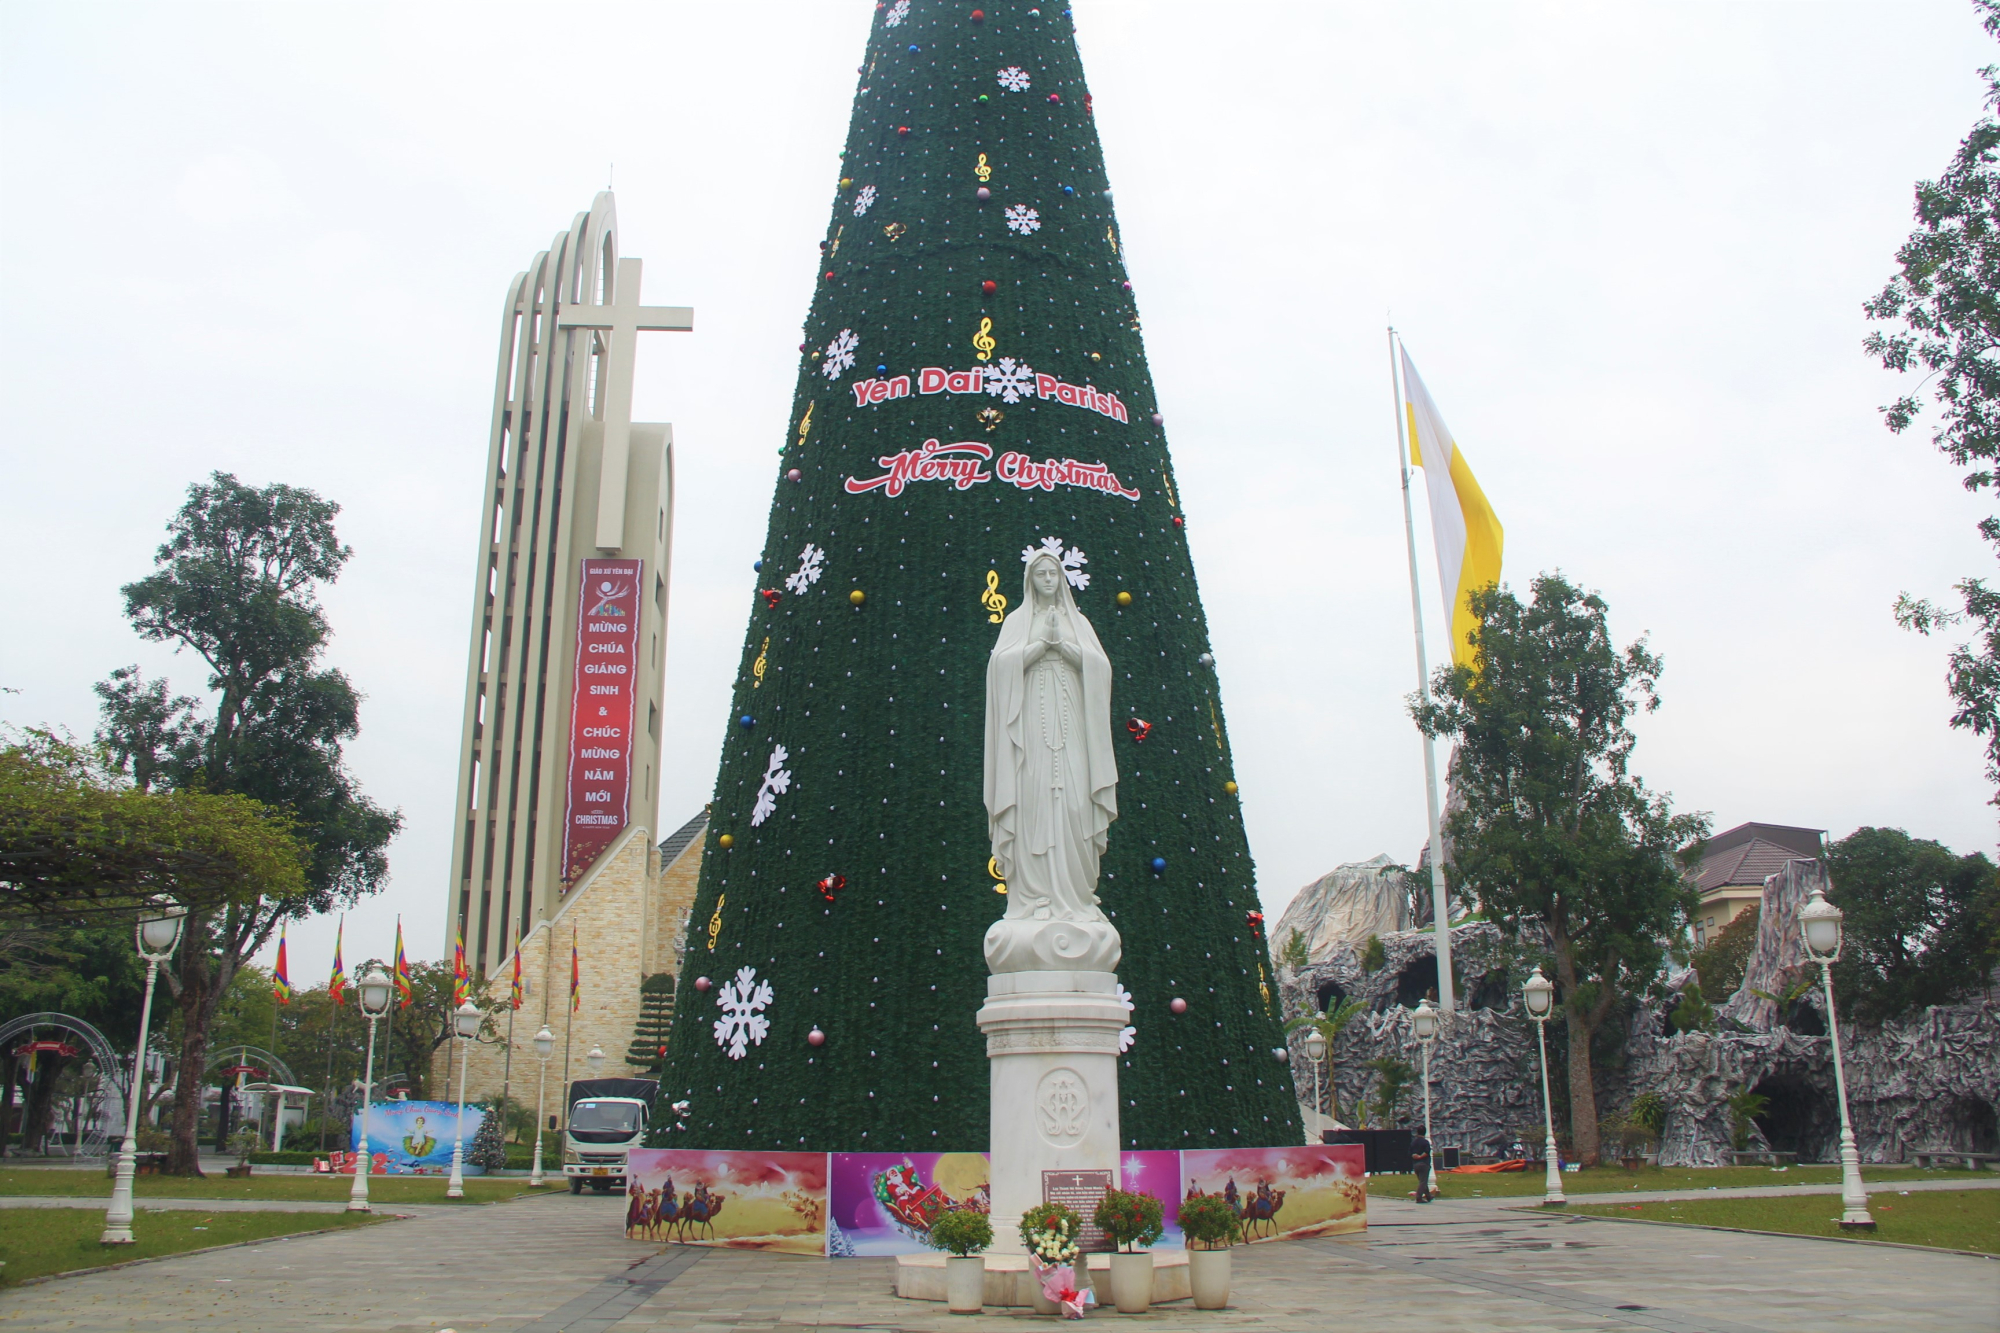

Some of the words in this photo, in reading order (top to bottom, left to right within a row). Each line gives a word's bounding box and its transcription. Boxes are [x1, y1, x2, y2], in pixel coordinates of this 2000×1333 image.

[852, 375, 911, 408] Yen
[918, 366, 984, 396] Dai
[1034, 372, 1130, 425] Parish
[844, 437, 994, 499] Merry
[995, 450, 1142, 502] Christmas
[588, 620, 628, 633] MỪNG
[588, 641, 625, 654] CHÚA
[584, 661, 627, 675] GIÁNG
[589, 684, 619, 695] SINH
[598, 706, 608, 716] &
[583, 725, 621, 738] CHÚC
[581, 746, 621, 759] MỪNG
[584, 768, 614, 781] NĂM
[585, 789, 611, 803] MỚI
[575, 814, 618, 825] CHRISTMAS
